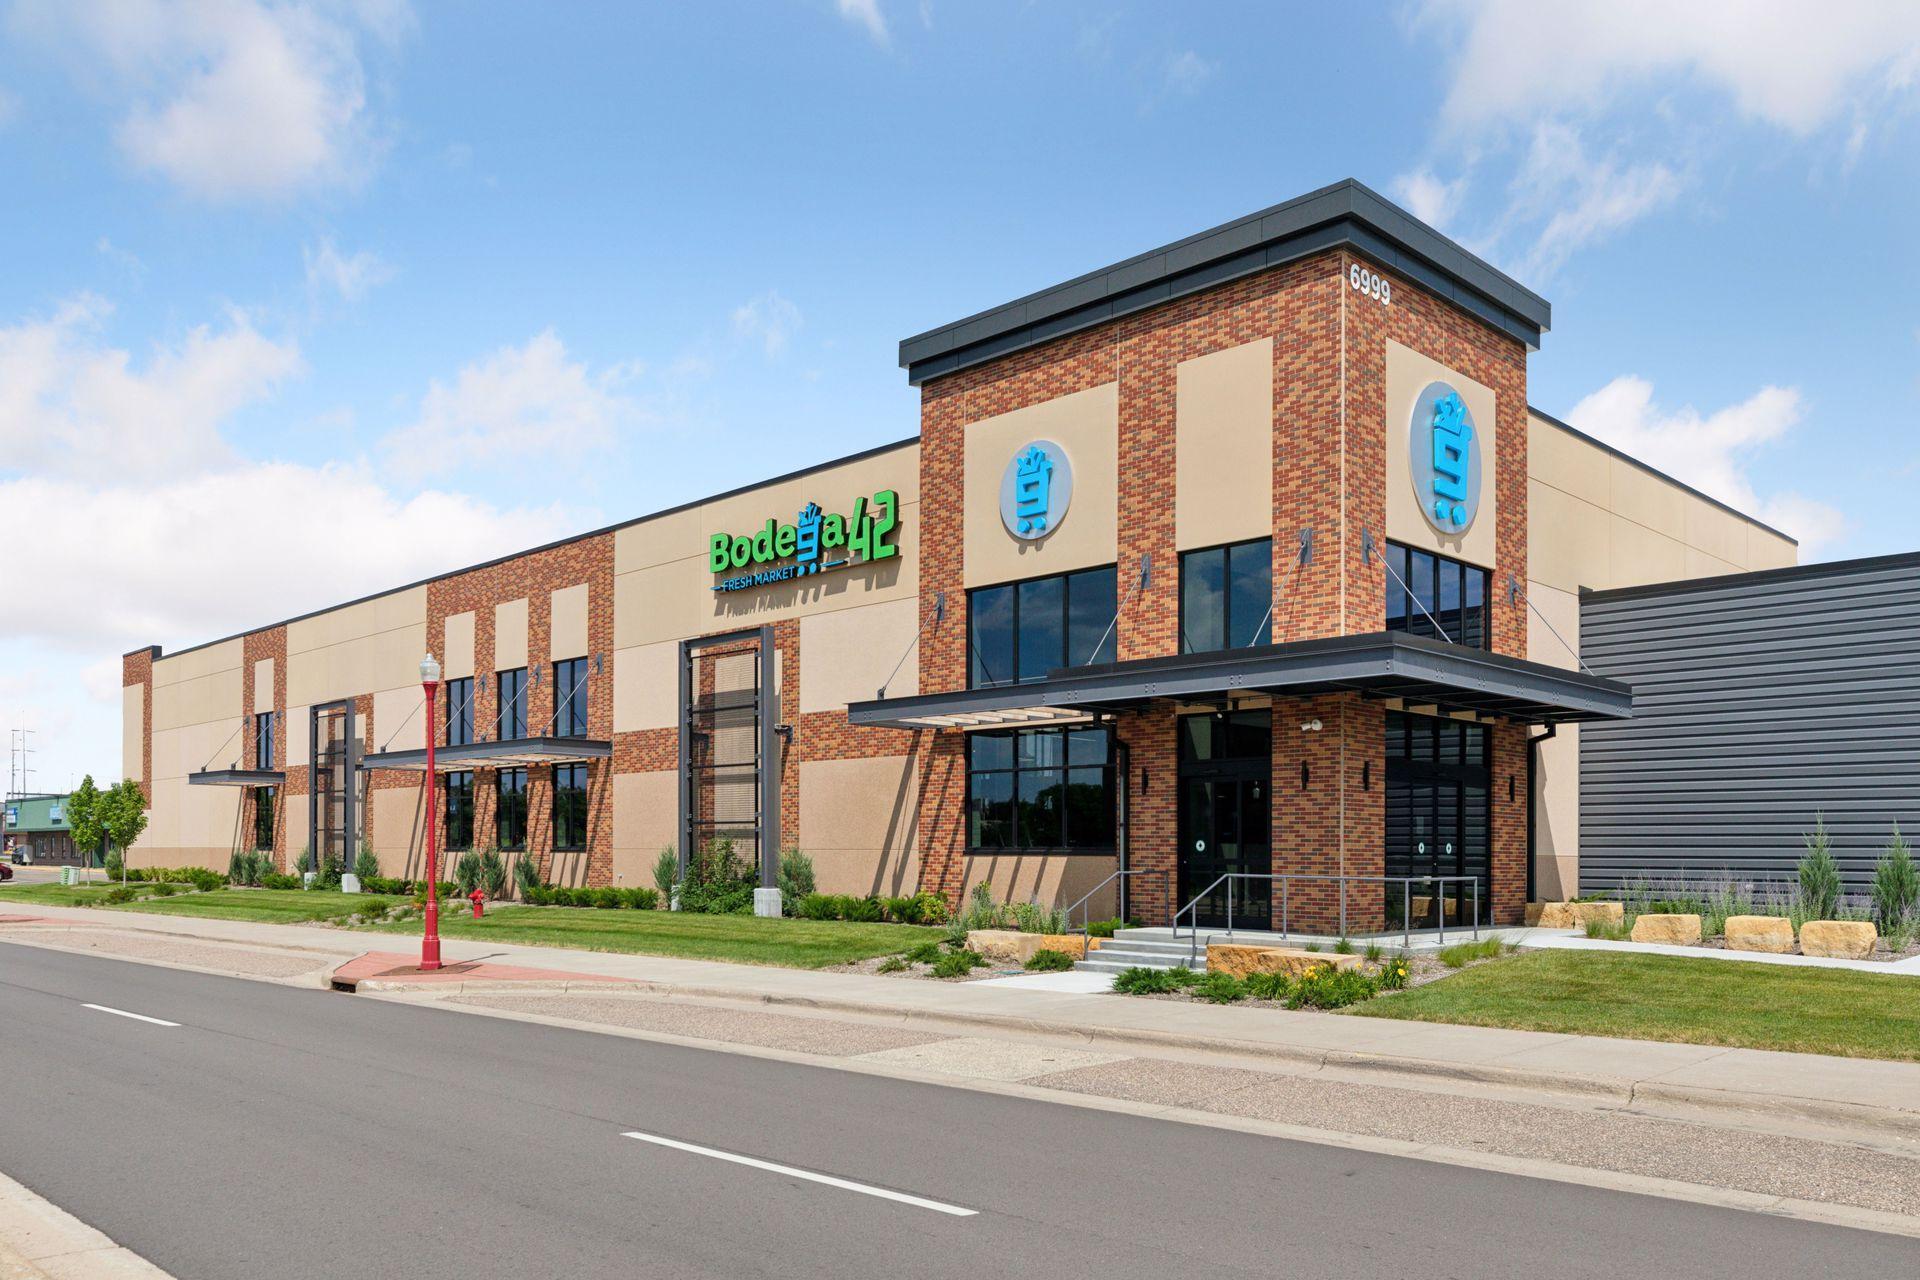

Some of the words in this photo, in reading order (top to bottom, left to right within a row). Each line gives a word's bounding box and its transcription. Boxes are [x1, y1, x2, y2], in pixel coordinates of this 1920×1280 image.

[1350, 264, 1390, 306] 6999
[709, 503, 847, 574] Bodega
[847, 489, 899, 562] 42
[722, 575, 753, 592] FRESH
[754, 566, 795, 586] MARKET
